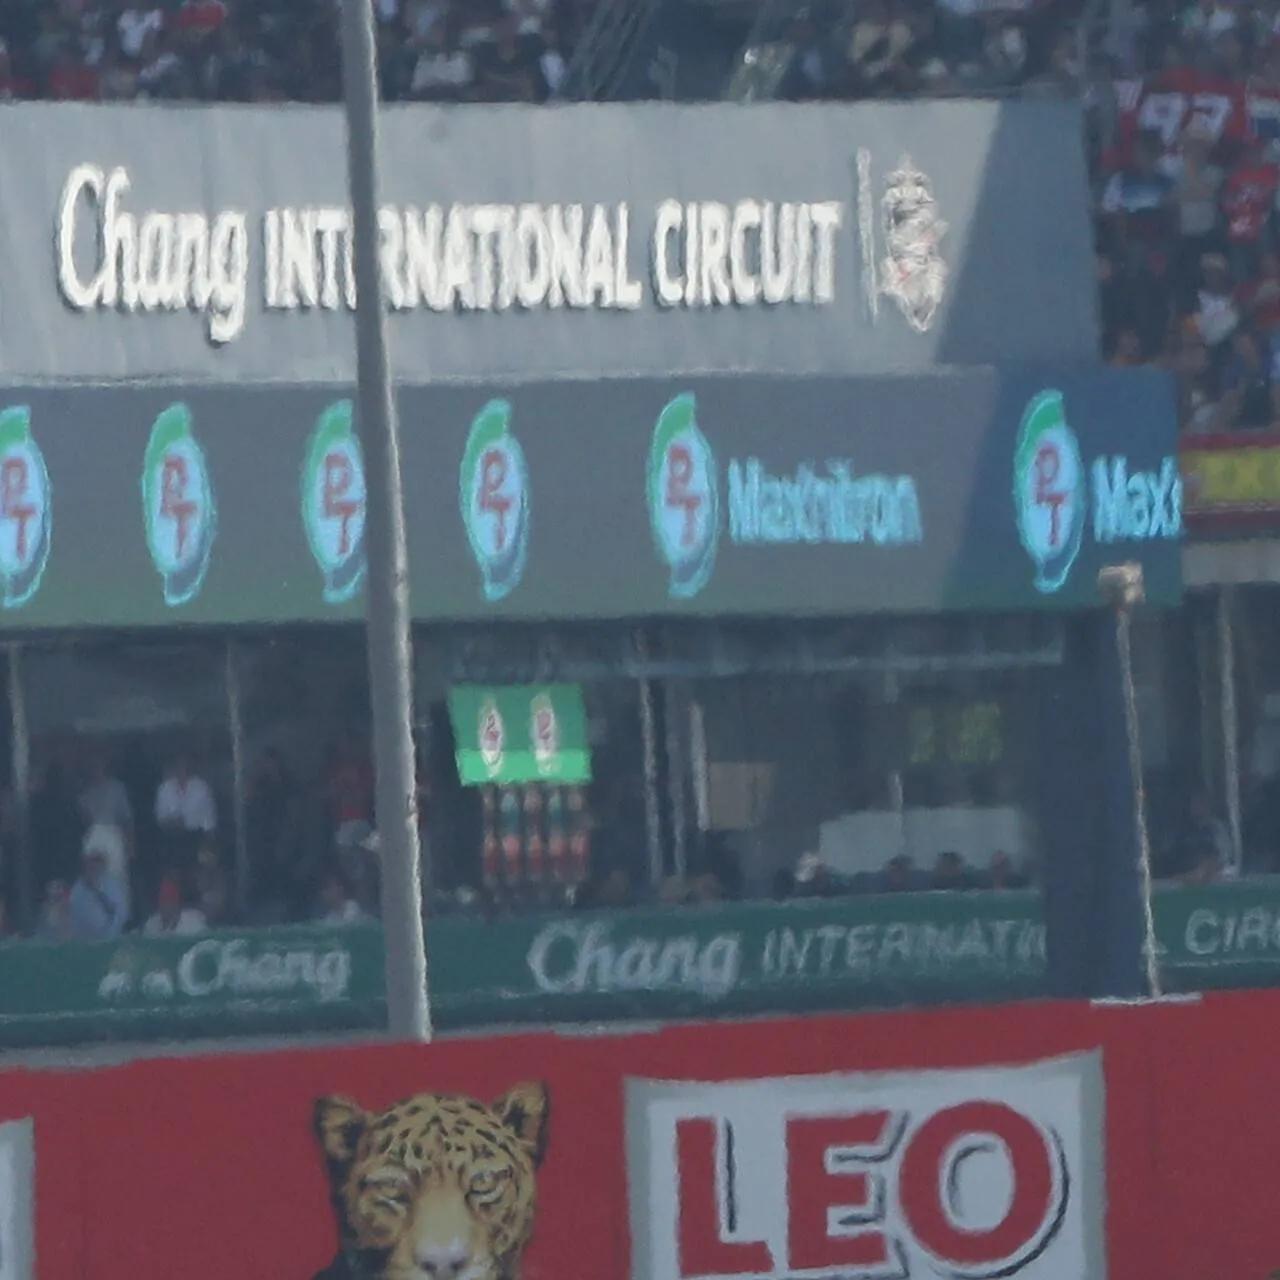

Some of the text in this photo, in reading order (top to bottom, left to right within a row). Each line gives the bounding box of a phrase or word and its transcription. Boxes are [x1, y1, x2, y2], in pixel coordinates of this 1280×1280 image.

[57, 162, 248, 344] Chang
[655, 198, 840, 305] CIRCUIT
[529, 921, 740, 995] Chang
